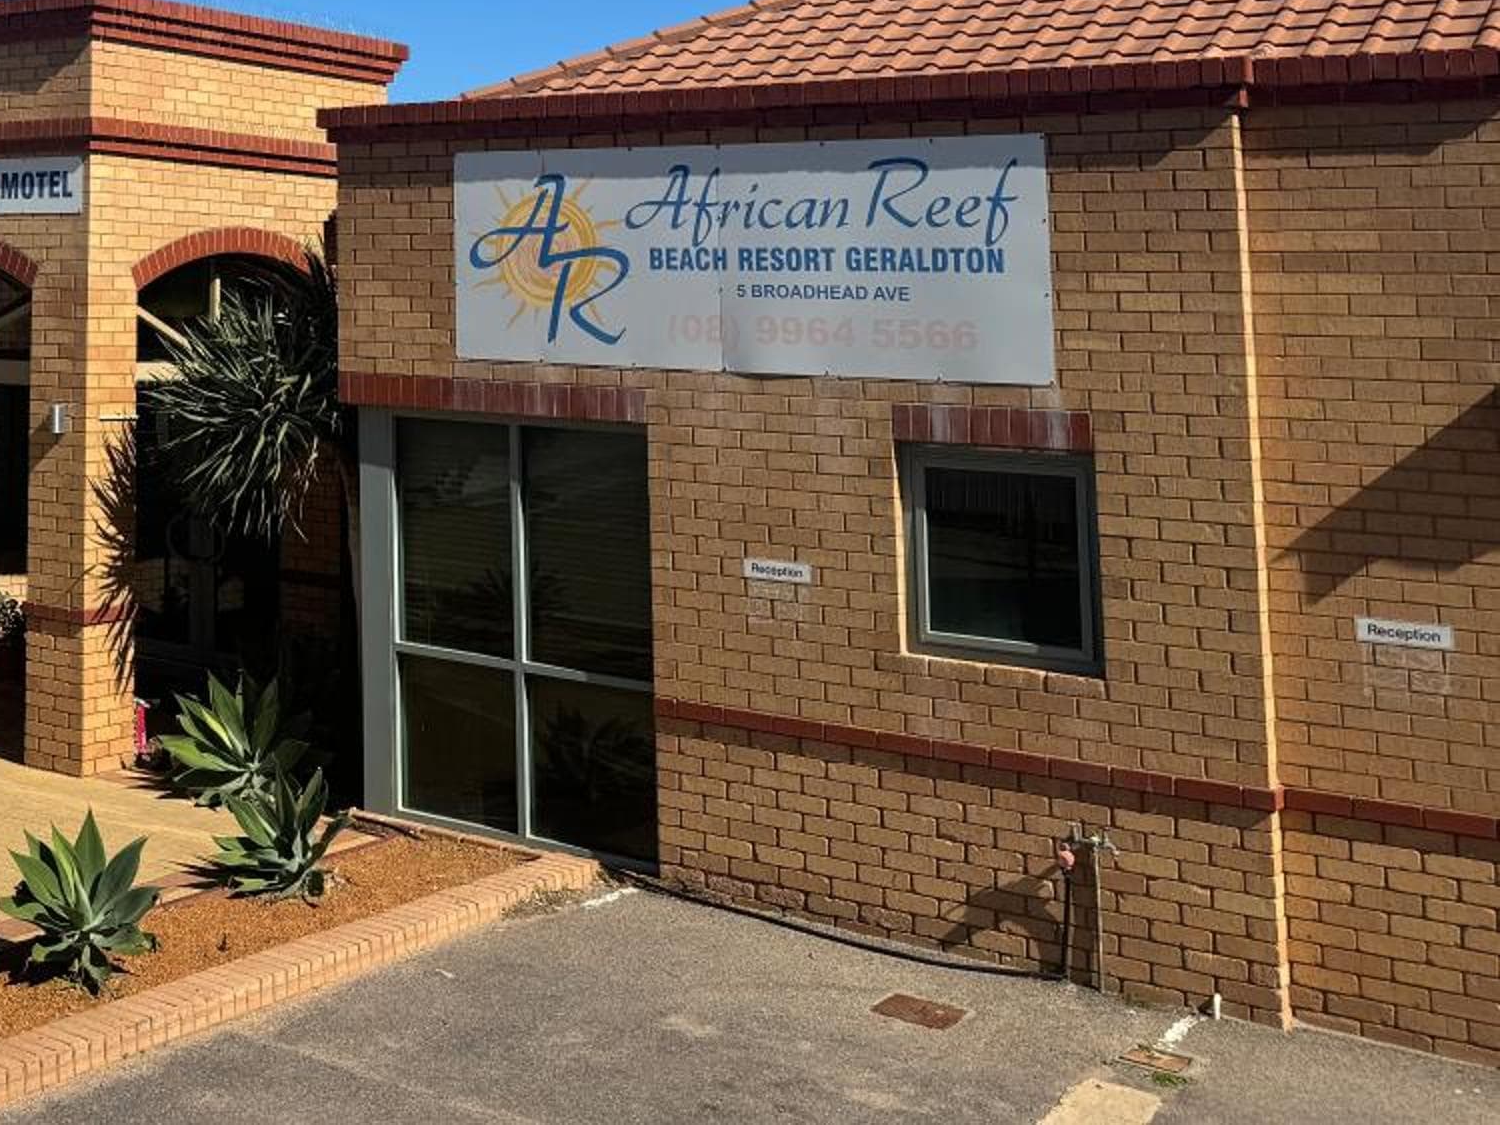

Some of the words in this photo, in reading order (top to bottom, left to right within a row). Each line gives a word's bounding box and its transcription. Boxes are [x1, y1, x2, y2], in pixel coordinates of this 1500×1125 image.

[0, 170, 73, 200] MOTEL
[625, 164, 849, 247] African
[866, 157, 1018, 247] Reef
[649, 247, 727, 272] BEACH
[738, 247, 836, 273] RESORT
[845, 247, 1005, 274] GERALDTON
[737, 284, 746, 298] 5
[751, 284, 869, 301] BROADHEAD
[873, 286, 911, 302] AVE
[667, 313, 741, 350] (08)
[755, 315, 854, 348] 9964
[871, 317, 980, 351] 5566
[751, 562, 803, 577] Reception
[1367, 623, 1441, 642] Reception
